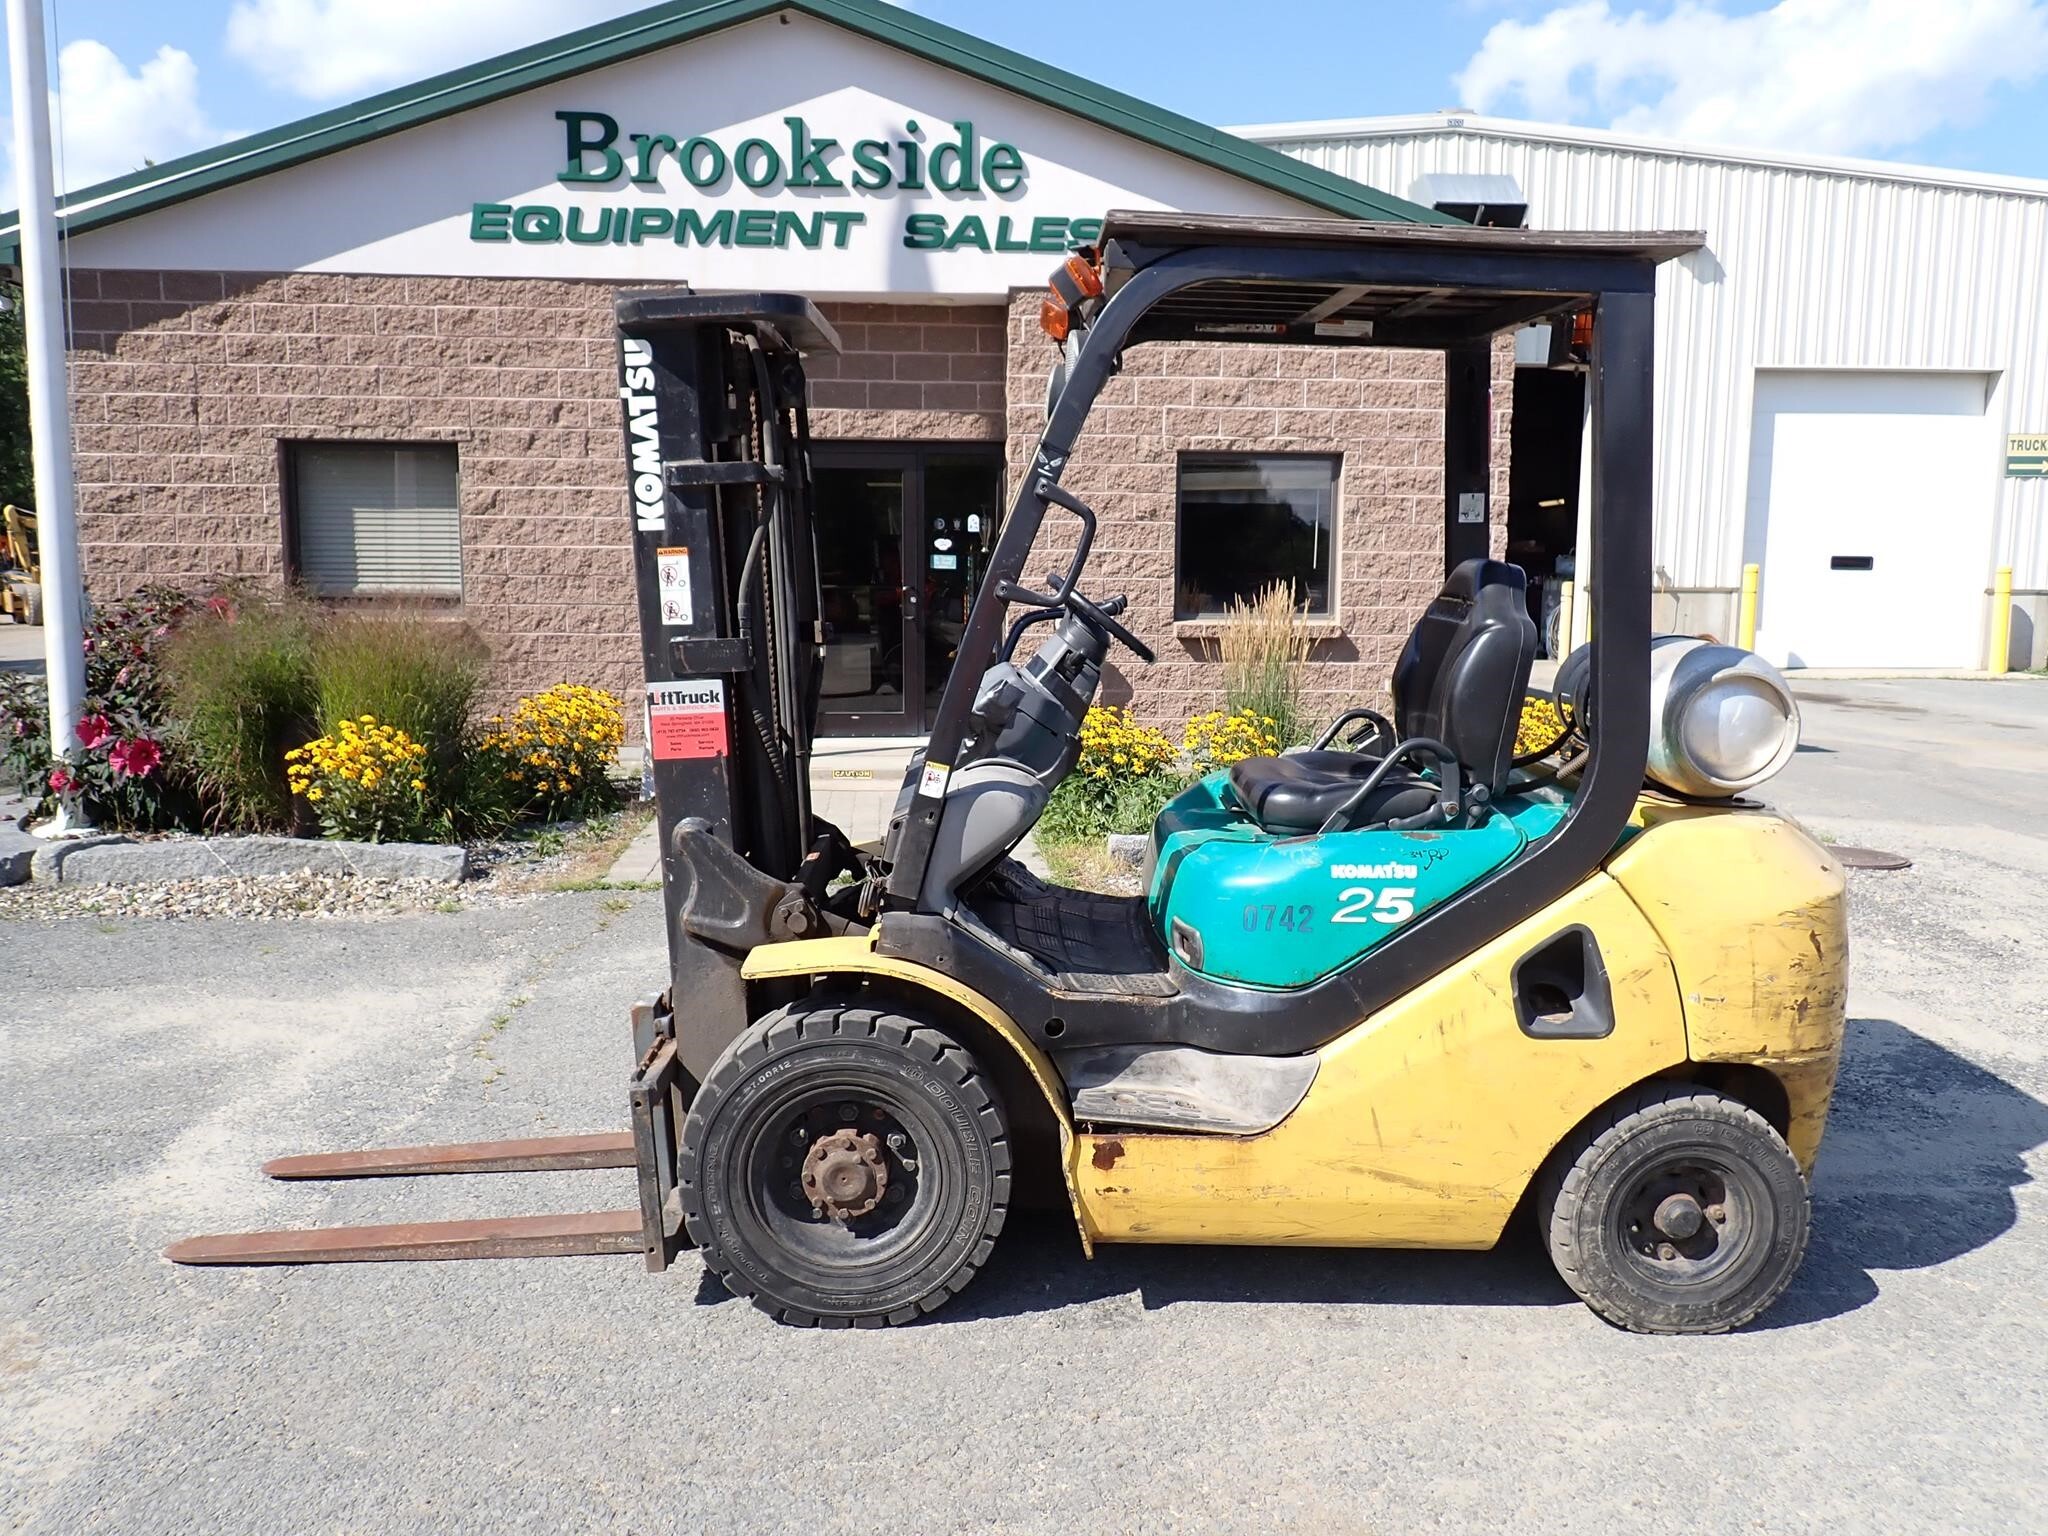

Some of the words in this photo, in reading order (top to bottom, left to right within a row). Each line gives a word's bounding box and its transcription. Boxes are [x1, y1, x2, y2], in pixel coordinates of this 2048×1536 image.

[554, 109, 1025, 193] Brookside
[469, 201, 865, 250] EQUIPMENT
[902, 212, 1105, 253] SALES
[620, 338, 666, 532] KOMATSU
[2010, 439, 2047, 451] TRUCK
[1330, 861, 1418, 879] KOMATSU
[1242, 905, 1314, 933] 0742
[1329, 886, 1417, 924] 25
[924, 1080, 983, 1174] DOUBLE
[955, 1185, 982, 1247] COIN
